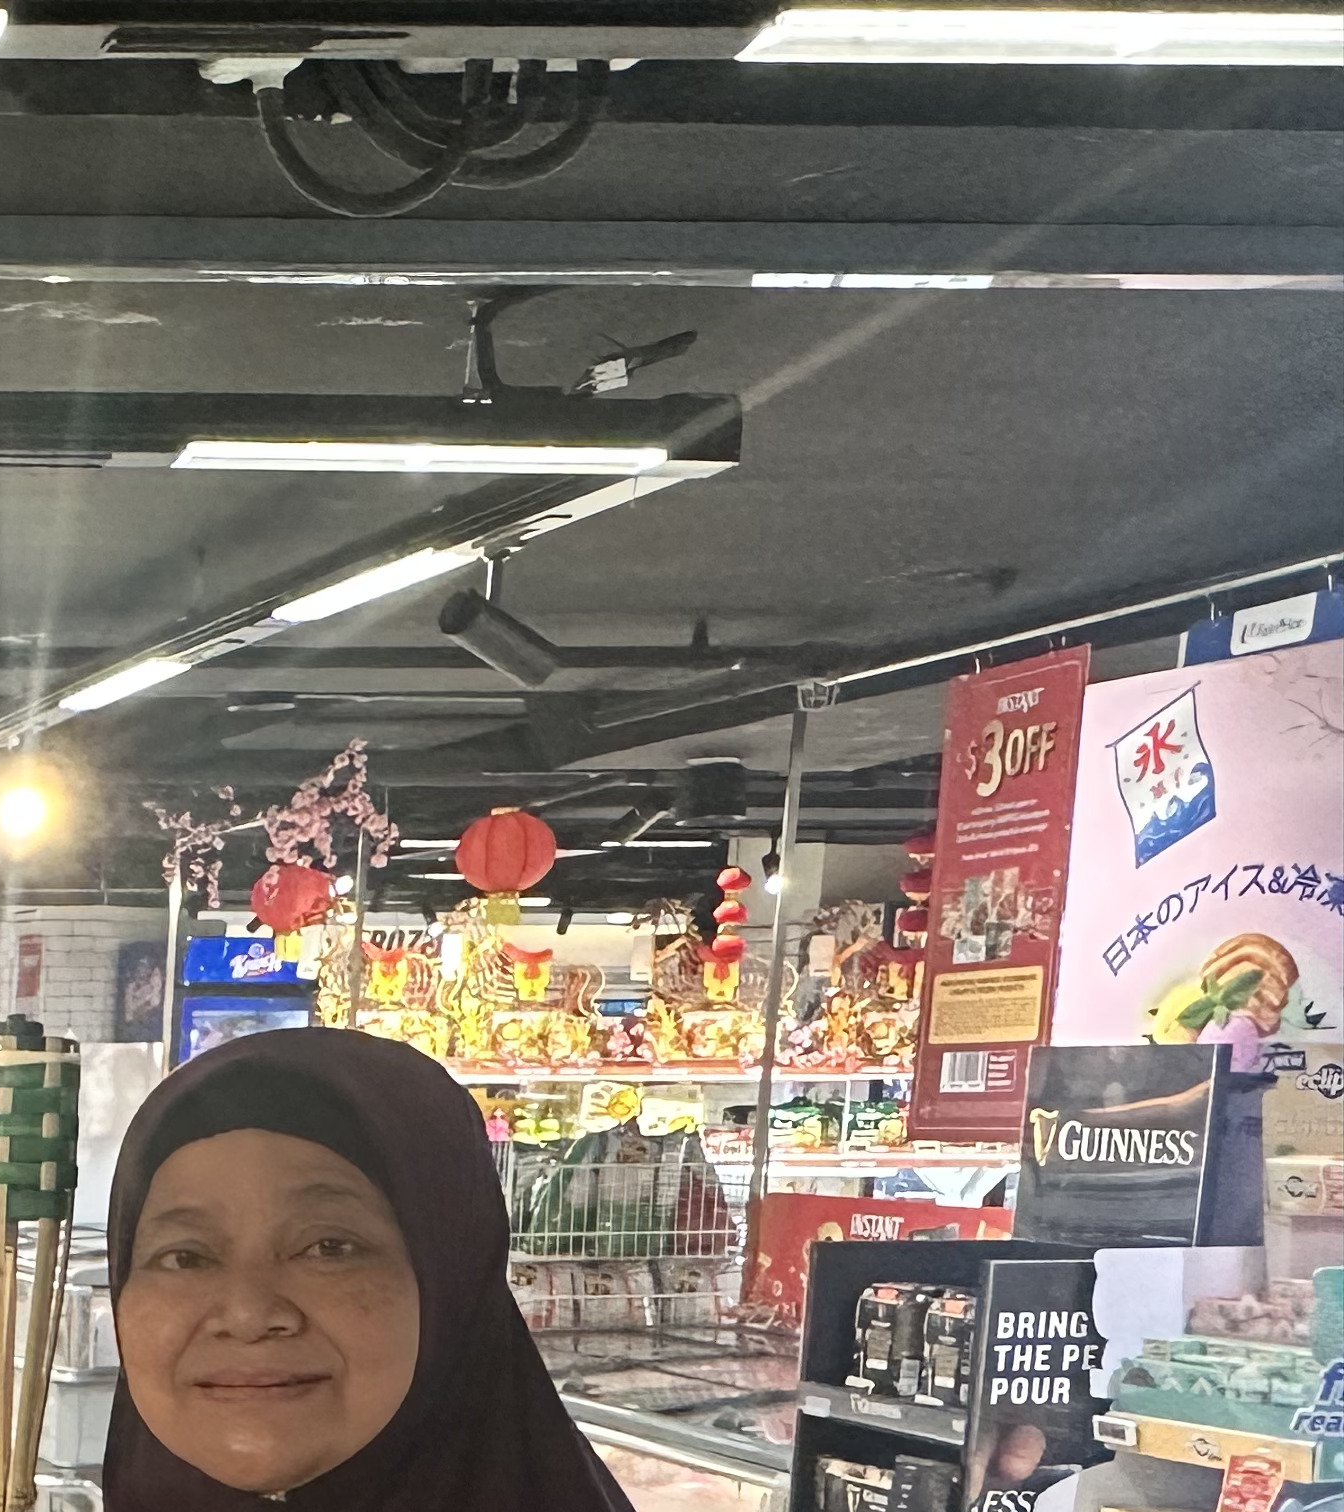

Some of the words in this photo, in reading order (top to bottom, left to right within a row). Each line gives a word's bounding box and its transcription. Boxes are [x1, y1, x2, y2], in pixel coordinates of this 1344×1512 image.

[1005, 722, 1057, 776] OFF
[1058, 1120, 1199, 1166] GUINNESS
[996, 1311, 1089, 1340] BRING
[993, 1343, 1052, 1372] THE
[989, 1376, 1071, 1405] POUR
